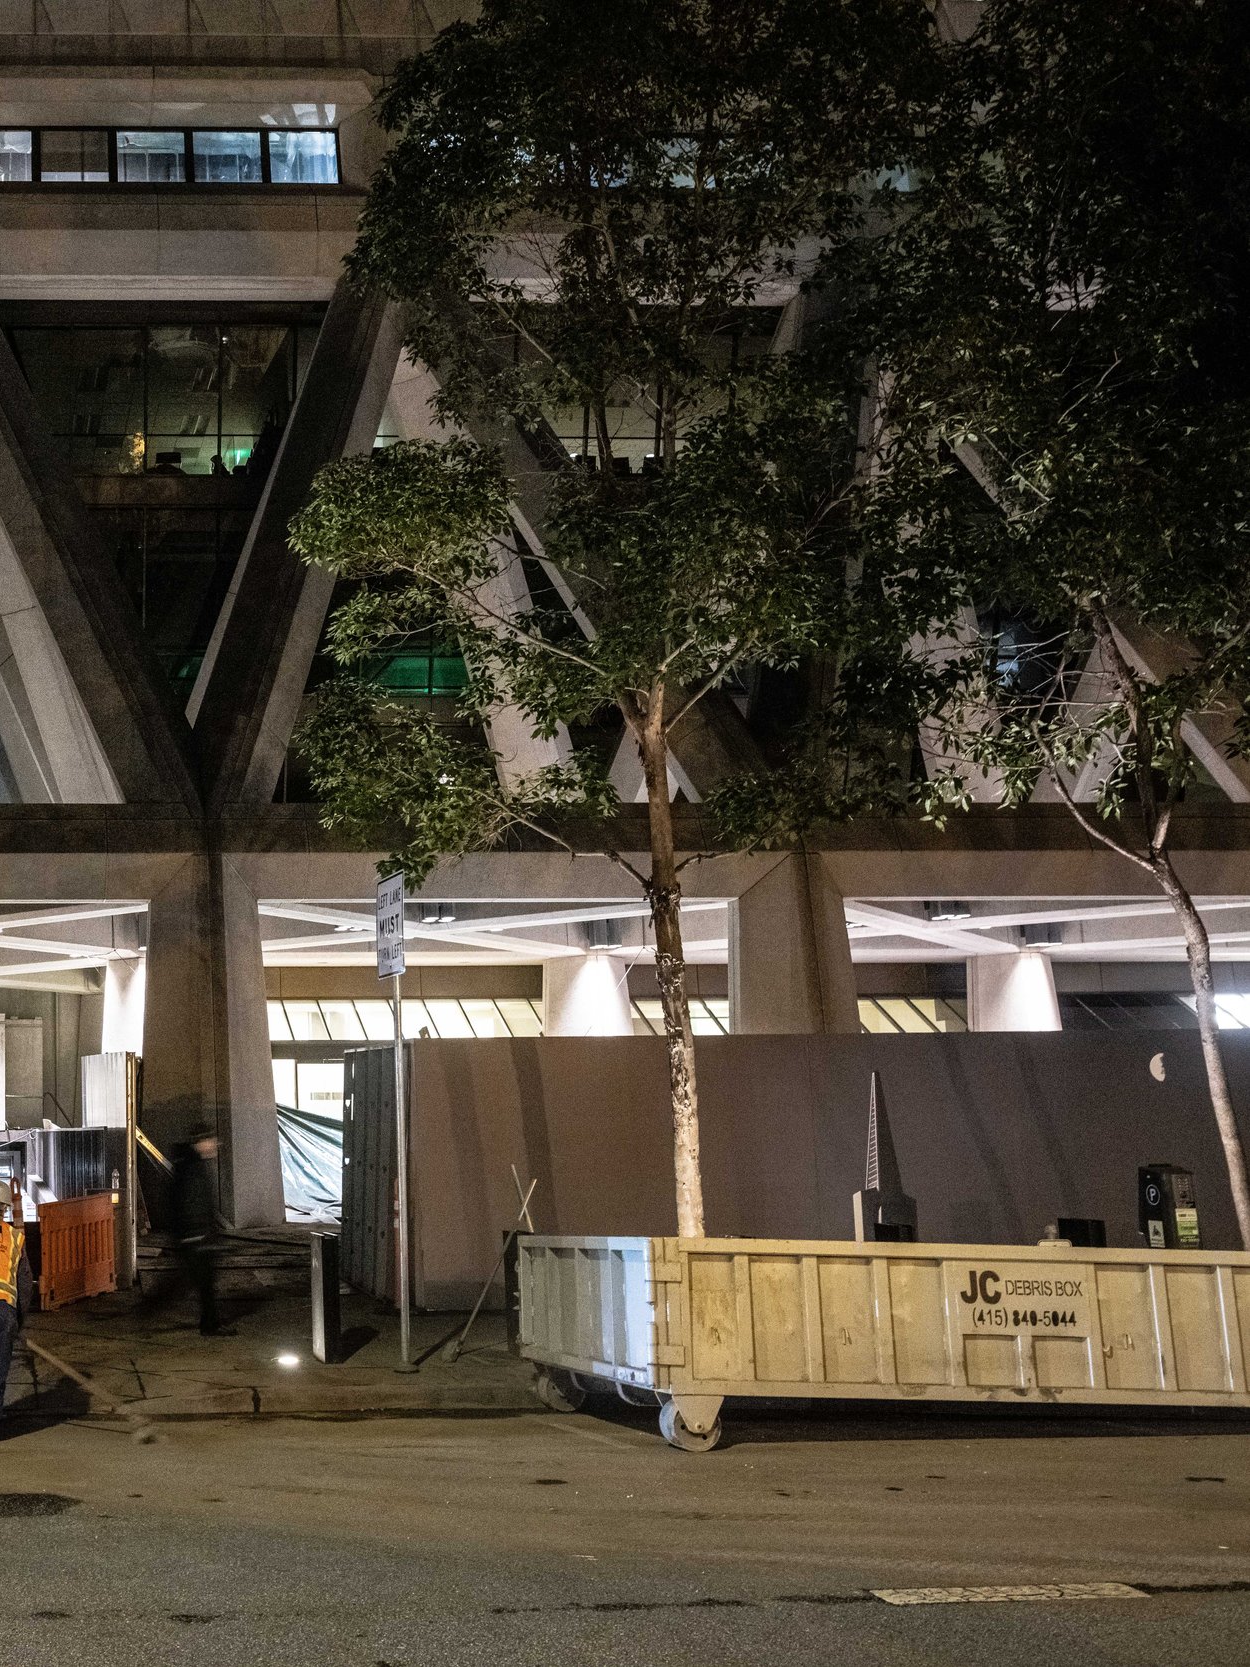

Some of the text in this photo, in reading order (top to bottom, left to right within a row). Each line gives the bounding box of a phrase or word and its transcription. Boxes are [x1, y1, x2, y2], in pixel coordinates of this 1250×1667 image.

[378, 887, 401, 910] LEFT LANE
[379, 913, 399, 938] MUST
[391, 942, 402, 960] LEFT
[960, 1270, 1083, 1304] JC DEBRIS BOX
[972, 1307, 1008, 1328] (415)
